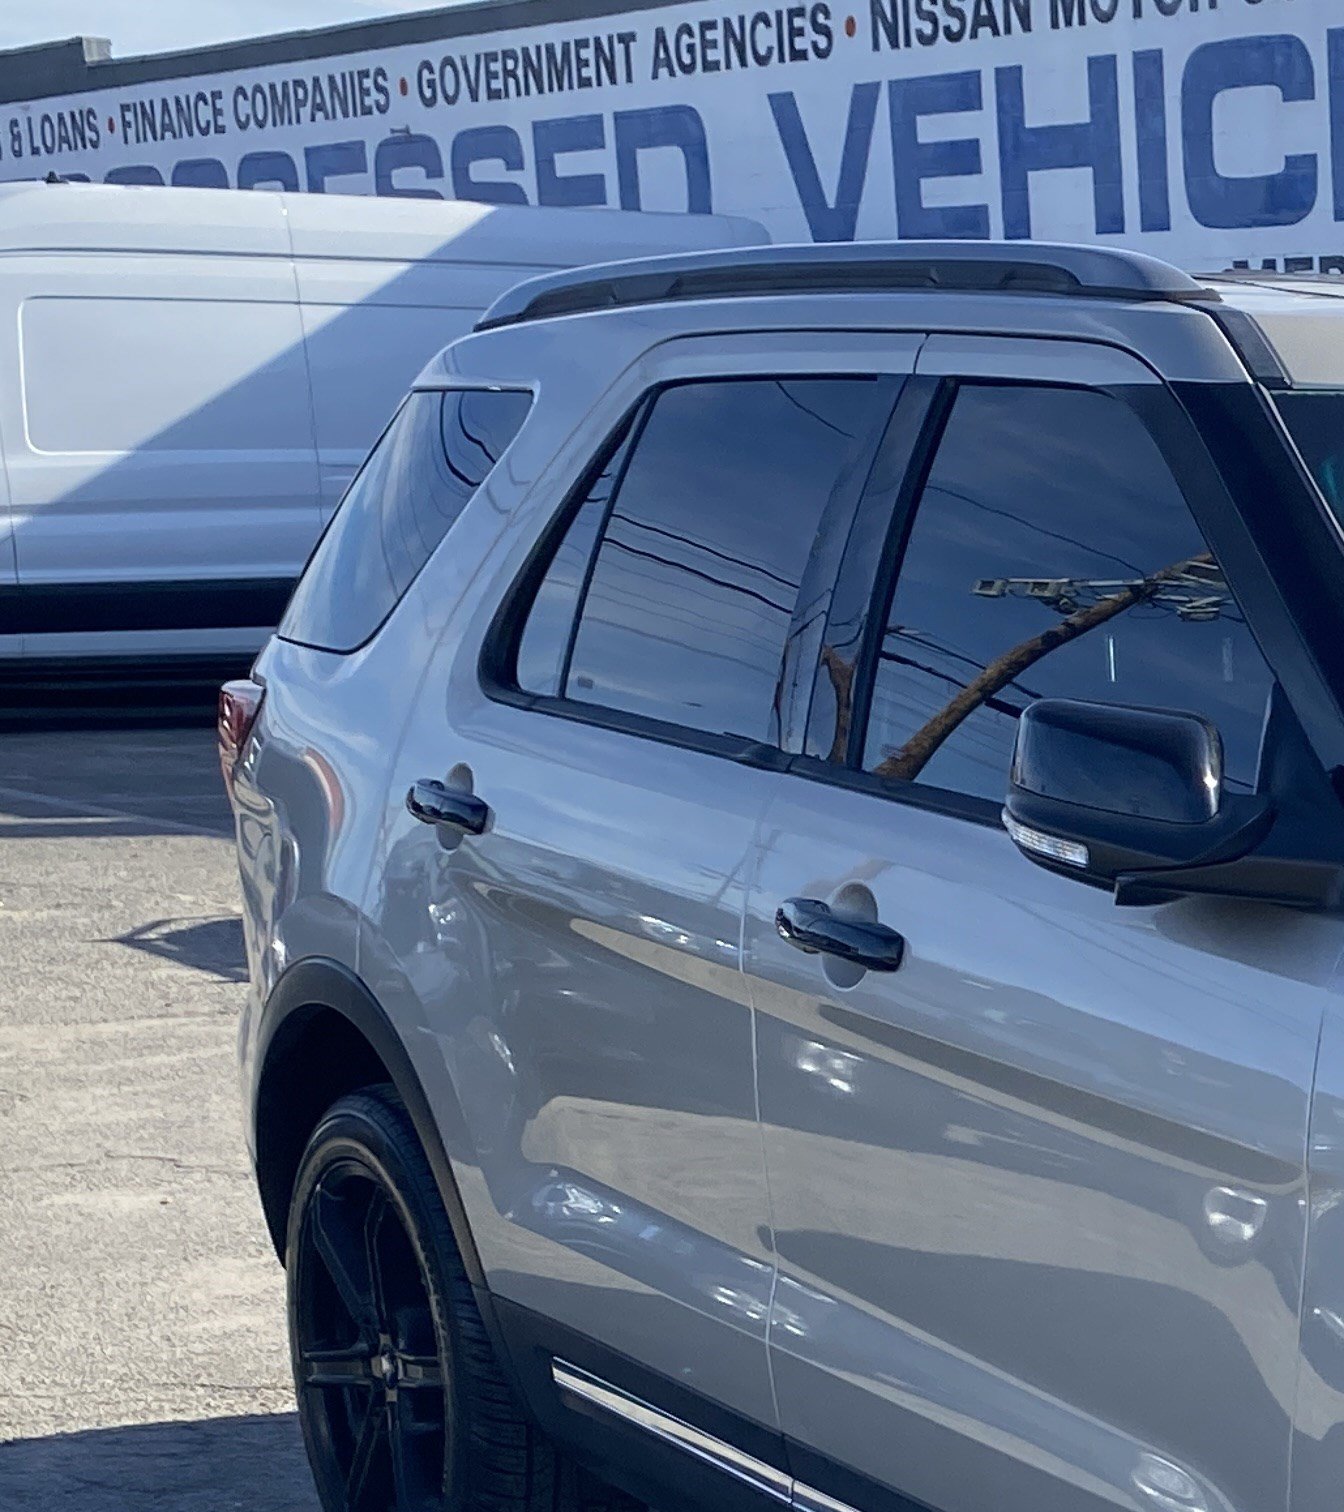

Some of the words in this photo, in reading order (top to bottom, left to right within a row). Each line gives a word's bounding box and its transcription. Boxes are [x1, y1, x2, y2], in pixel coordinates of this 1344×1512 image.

[9, 117, 25, 158] &
[27, 106, 101, 158] LOANS
[120, 89, 227, 145] FINANCE
[233, 66, 390, 132] COMPANIES
[416, 31, 638, 108] GOVERNMENT
[651, 2, 834, 81] AGENCIES
[871, 0, 1033, 52] NISSAN
